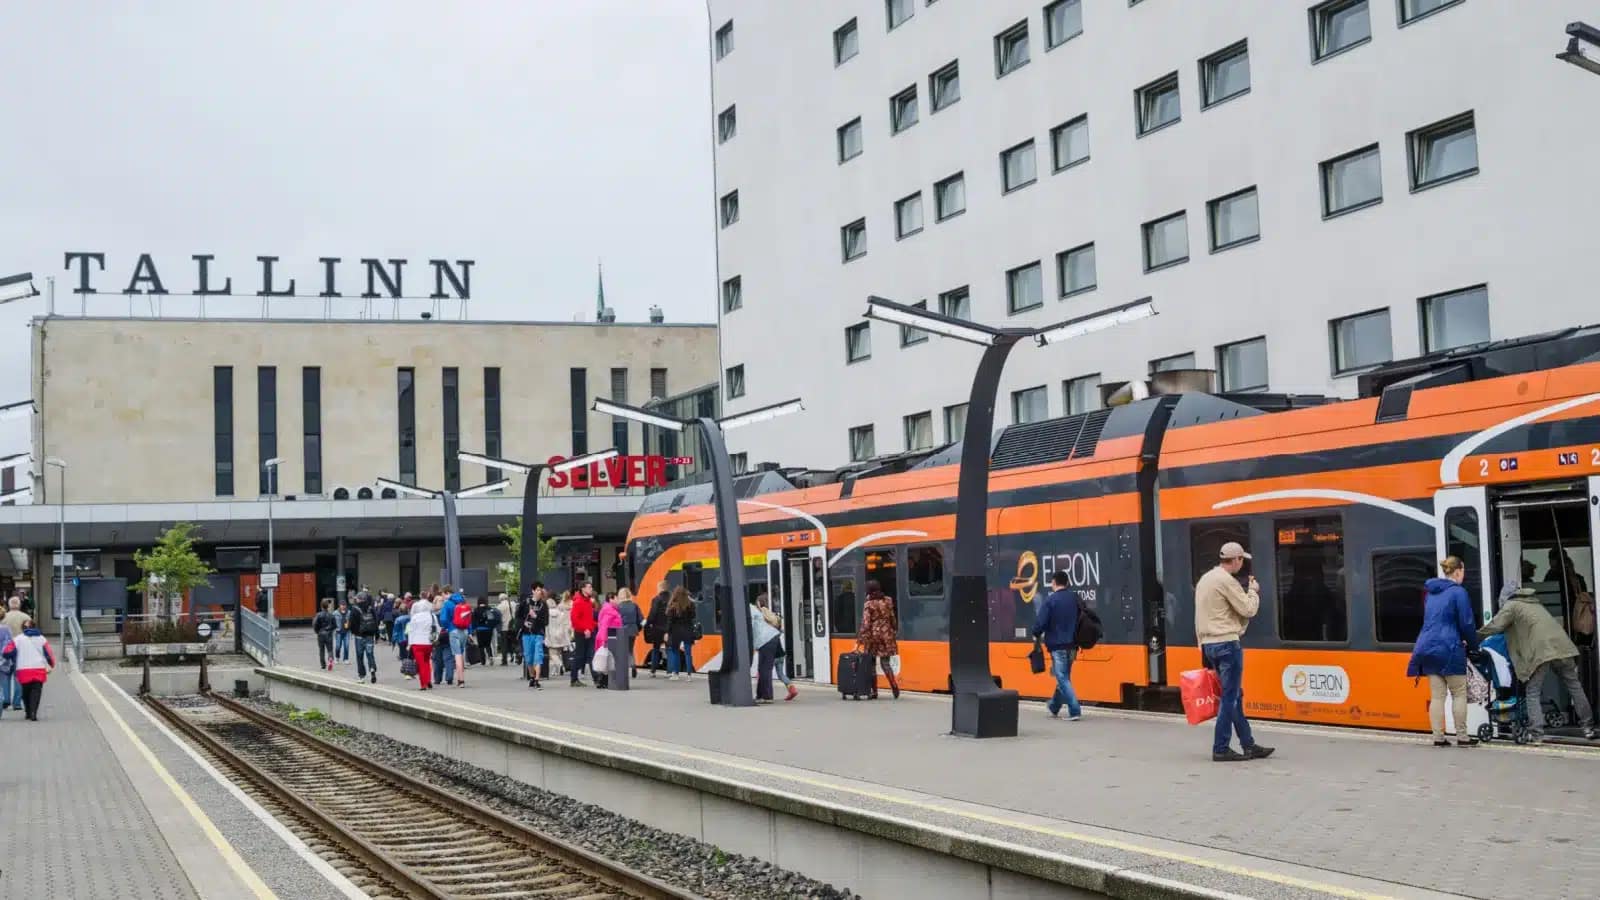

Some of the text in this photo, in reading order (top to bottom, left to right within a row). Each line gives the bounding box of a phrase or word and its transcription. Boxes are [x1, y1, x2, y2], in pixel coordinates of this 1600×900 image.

[65, 252, 475, 299] TALLINN
[548, 455, 667, 488] SELVER
[1480, 459, 1489, 477] 2
[1309, 674, 1343, 691] ELRON
